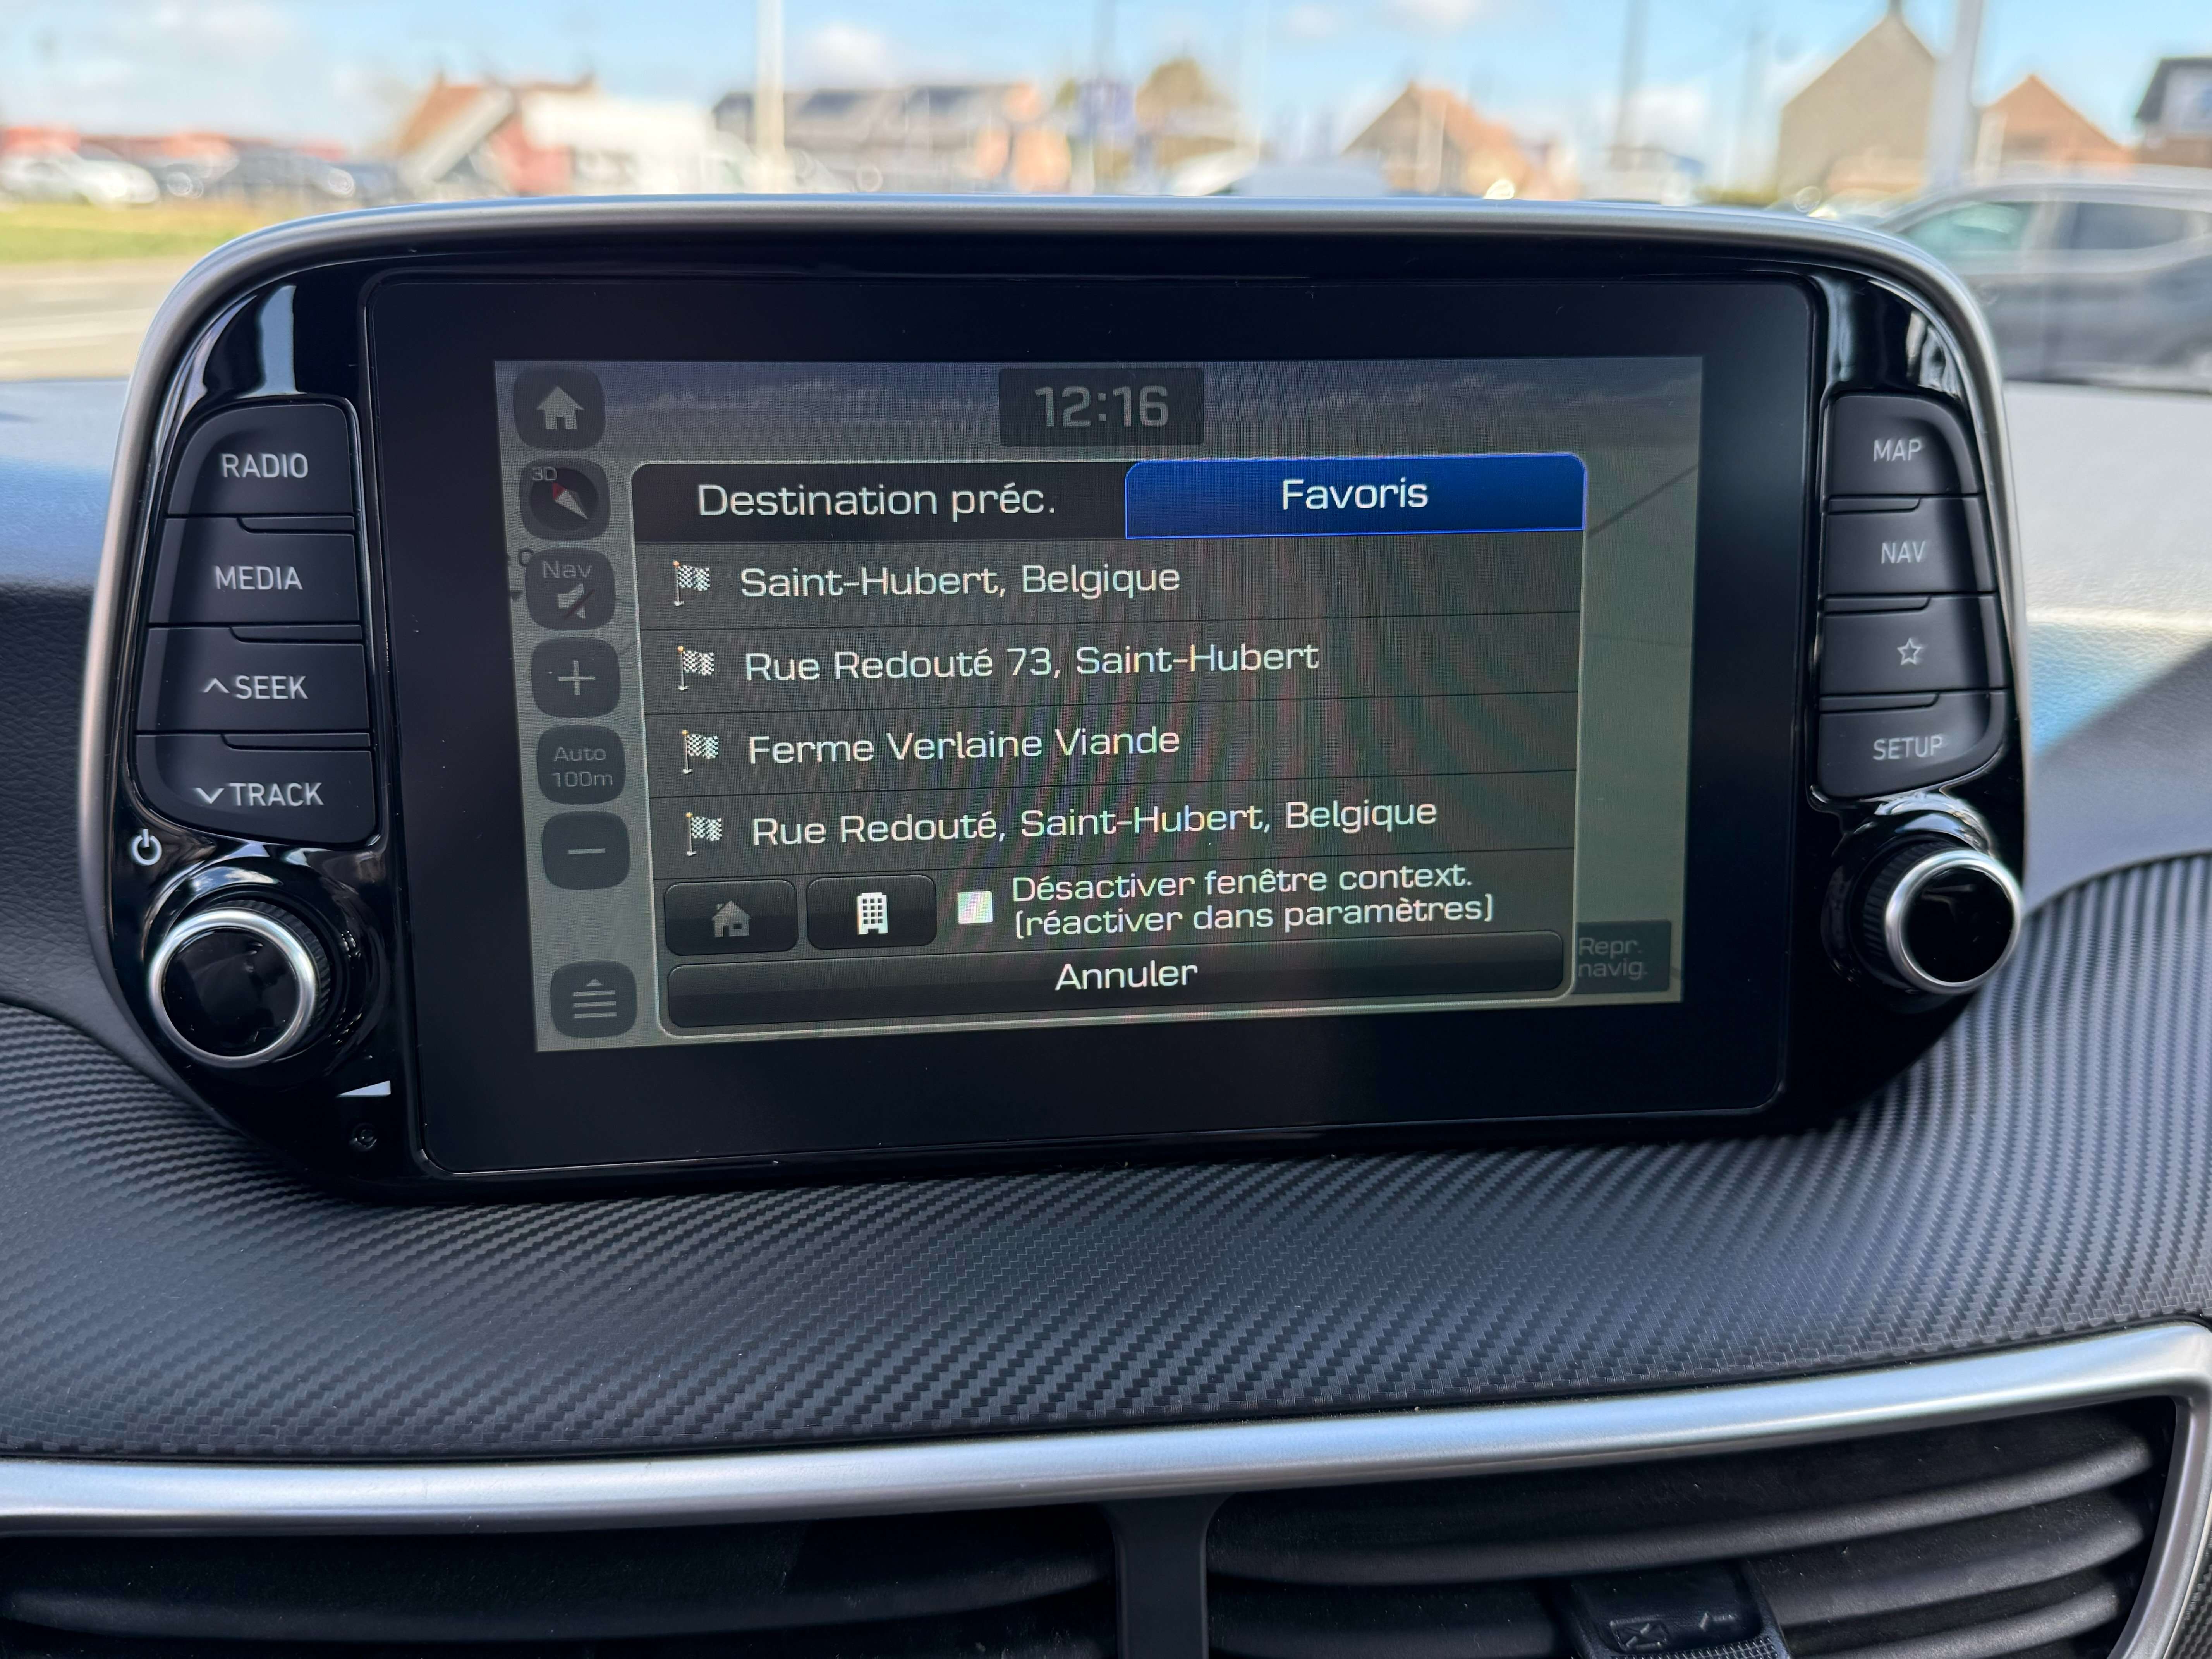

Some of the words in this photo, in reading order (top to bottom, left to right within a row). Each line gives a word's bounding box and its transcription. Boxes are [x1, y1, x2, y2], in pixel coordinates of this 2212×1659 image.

[1036, 386, 1169, 428] 12:16
[1873, 439, 1922, 461] MAP
[222, 453, 308, 478] RADIO
[532, 466, 557, 481] 3D
[698, 484, 938, 516] Destination
[952, 483, 1056, 522] préc.
[1282, 476, 1429, 510] Favoris
[1881, 541, 1926, 563] NAV
[215, 566, 302, 591] MEDIA
[543, 560, 592, 578] Nav
[740, 567, 1006, 599] Saint-Hubert,
[1022, 565, 1180, 601] Belgique
[746, 652, 821, 681] Rue
[835, 648, 993, 680] Redouté
[1008, 649, 1060, 680] 73,
[1076, 643, 1319, 675] Saint-Hubert
[236, 676, 308, 699] SEEK
[554, 745, 606, 762] Auto
[749, 735, 874, 764] Ferme
[887, 729, 1042, 760] Verlaine
[1056, 726, 1180, 757] Viande
[1873, 736, 1943, 760] SETUP
[553, 770, 613, 787] 100m
[232, 783, 324, 807] TRACK
[752, 817, 826, 845] Rue
[840, 811, 1006, 843] Redouté,
[1021, 804, 1271, 838] Saint-Hubert,
[1286, 801, 1436, 833] Belgique
[1014, 872, 1195, 902] Désactiver
[1205, 868, 1327, 894] fenêtre
[1339, 864, 1473, 891] context.
[1015, 907, 1183, 939] (réactiver
[1194, 906, 1273, 931] dans
[1285, 894, 1493, 933] paramètres)
[1578, 937, 1643, 960] Repr.
[1056, 962, 1197, 991] Annuler
[1578, 957, 1648, 981] navig.
